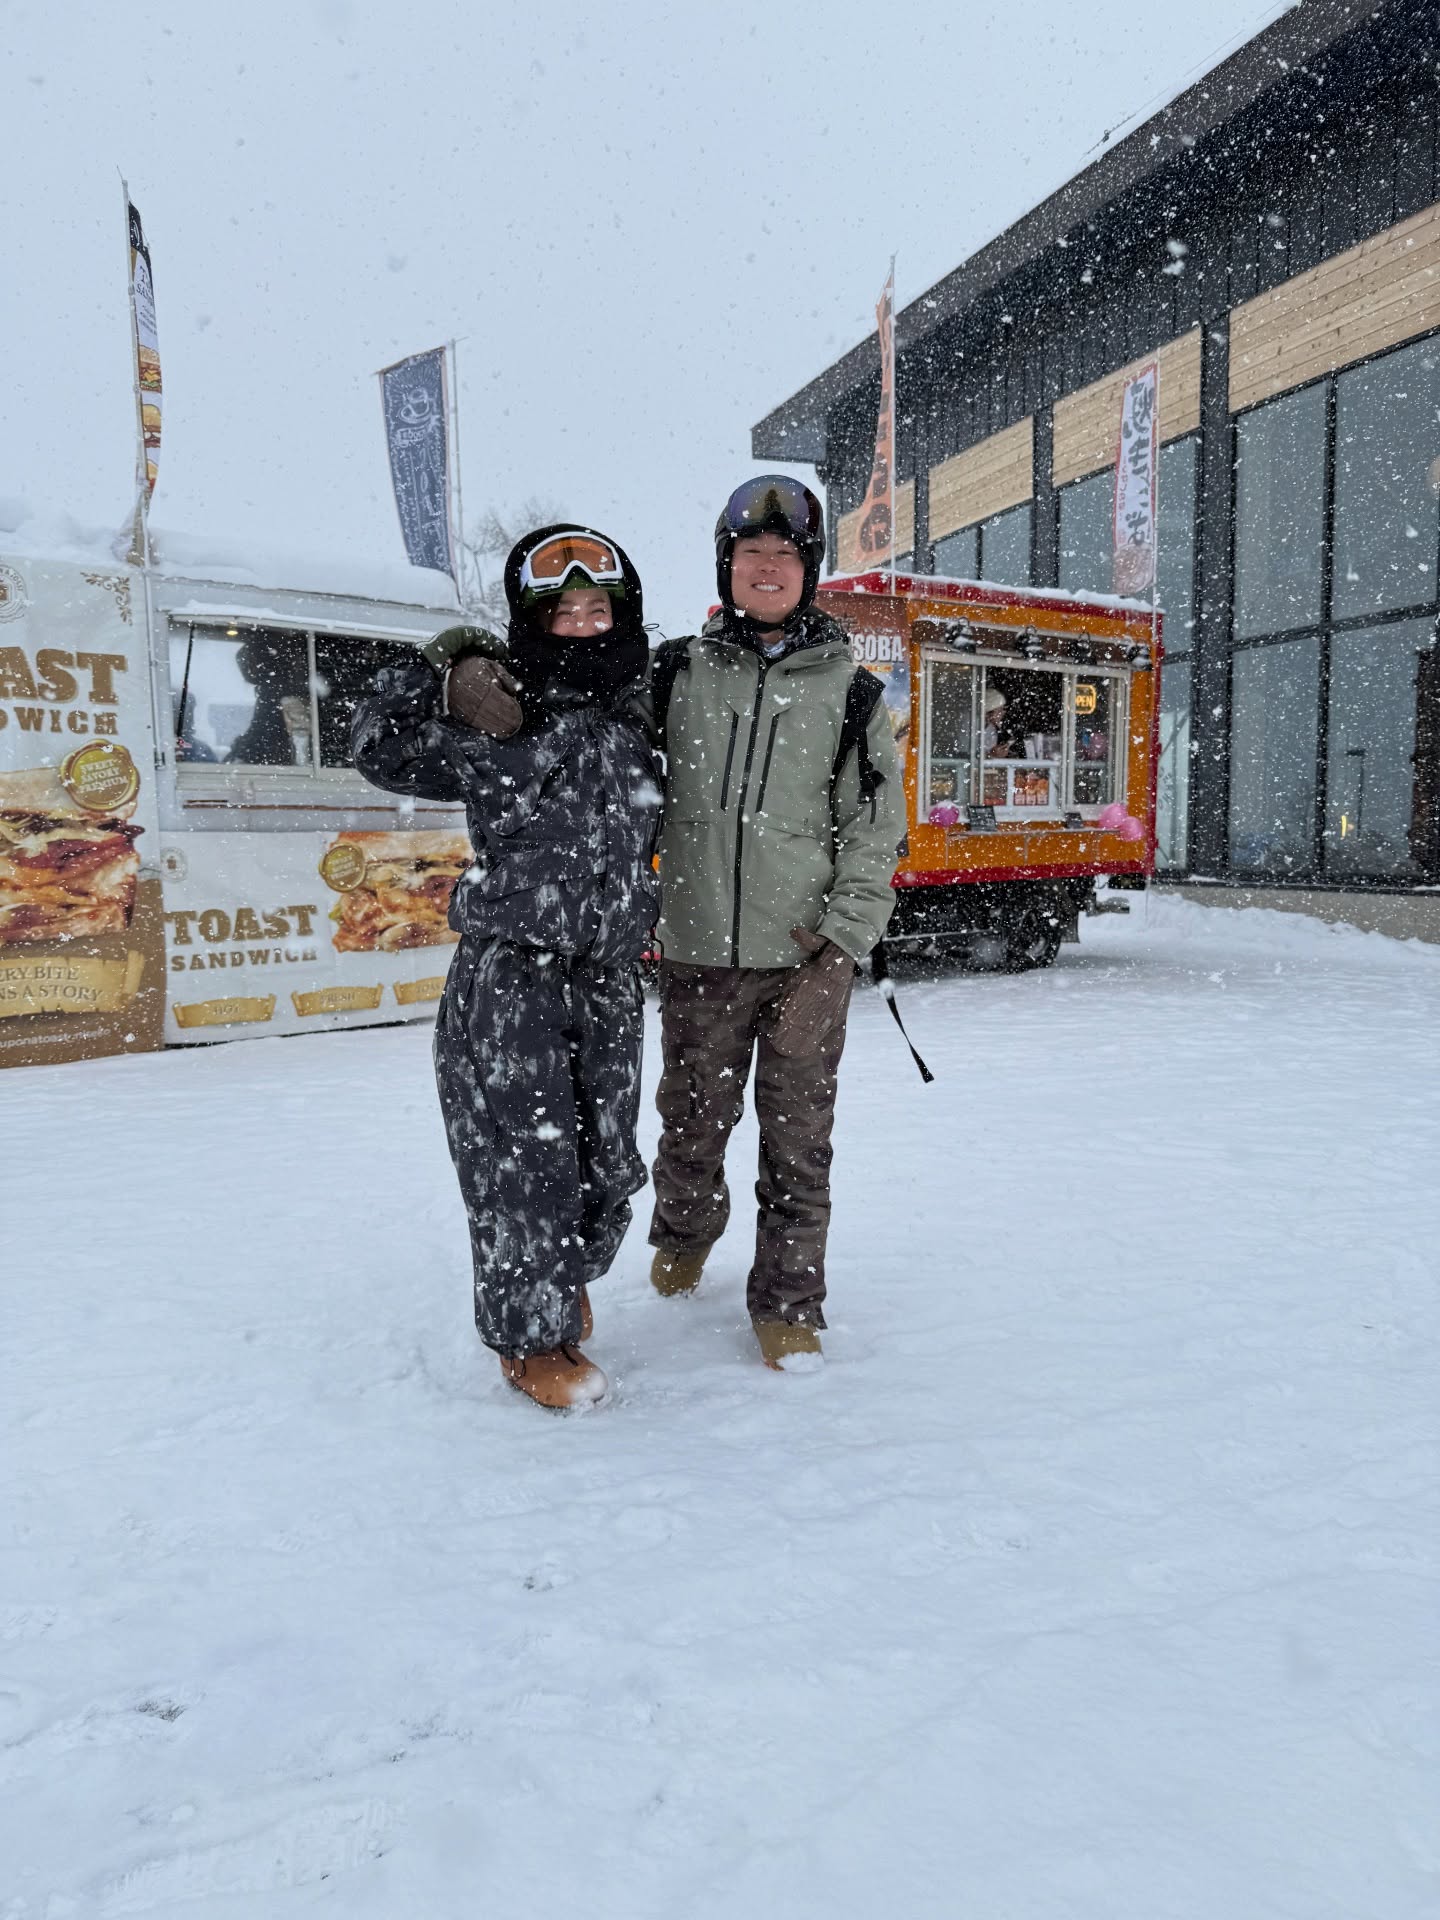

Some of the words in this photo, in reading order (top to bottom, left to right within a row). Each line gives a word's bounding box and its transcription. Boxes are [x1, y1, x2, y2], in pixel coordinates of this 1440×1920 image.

[464, 627, 492, 639] LOV
[850, 633, 903, 663] SOBA
[1075, 695, 1093, 707] PEN
[163, 905, 318, 945] TOAST
[171, 948, 317, 971] SANDWICH
[34, 966, 80, 980] BITE
[22, 985, 34, 999] A
[39, 984, 103, 1001] STORY
